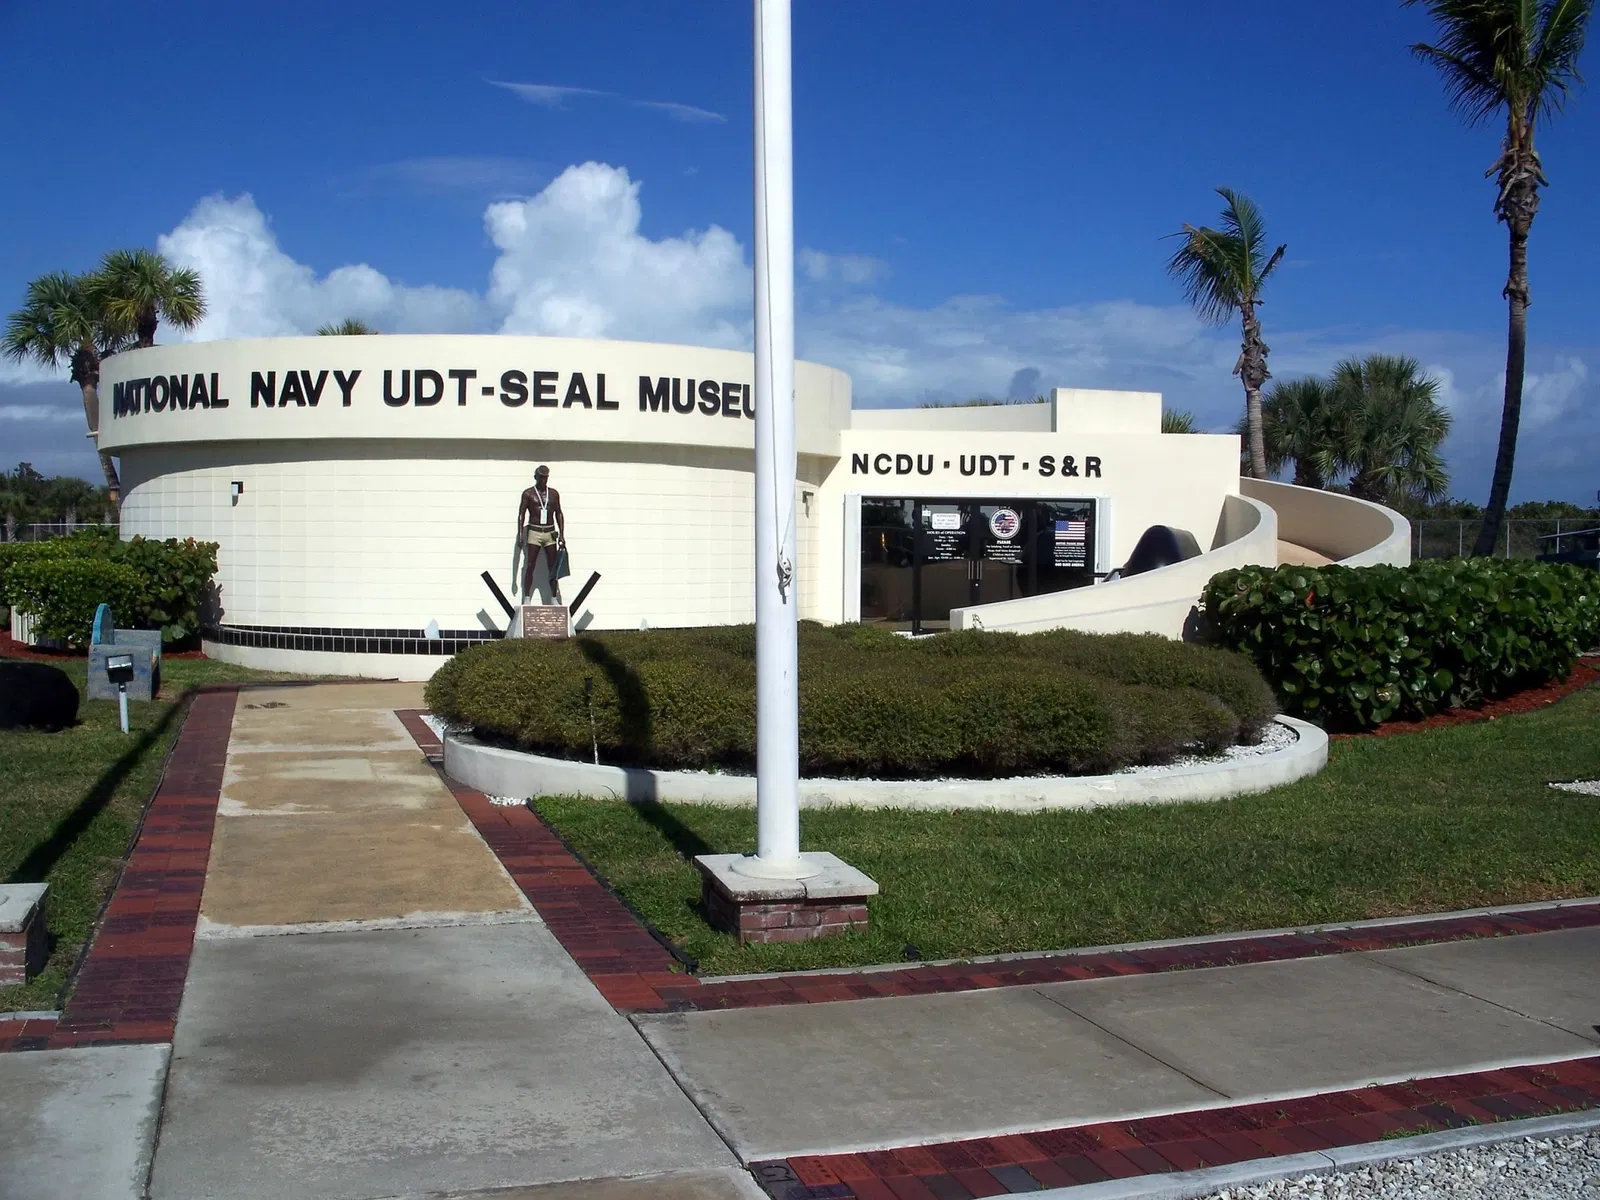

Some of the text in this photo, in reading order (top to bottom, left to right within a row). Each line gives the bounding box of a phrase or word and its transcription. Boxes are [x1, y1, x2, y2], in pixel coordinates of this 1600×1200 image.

[113, 370, 756, 419] NATIONAL NAVY UDT-SEAL MUSEU
[852, 453, 1102, 478] NCDU UDT S&R
